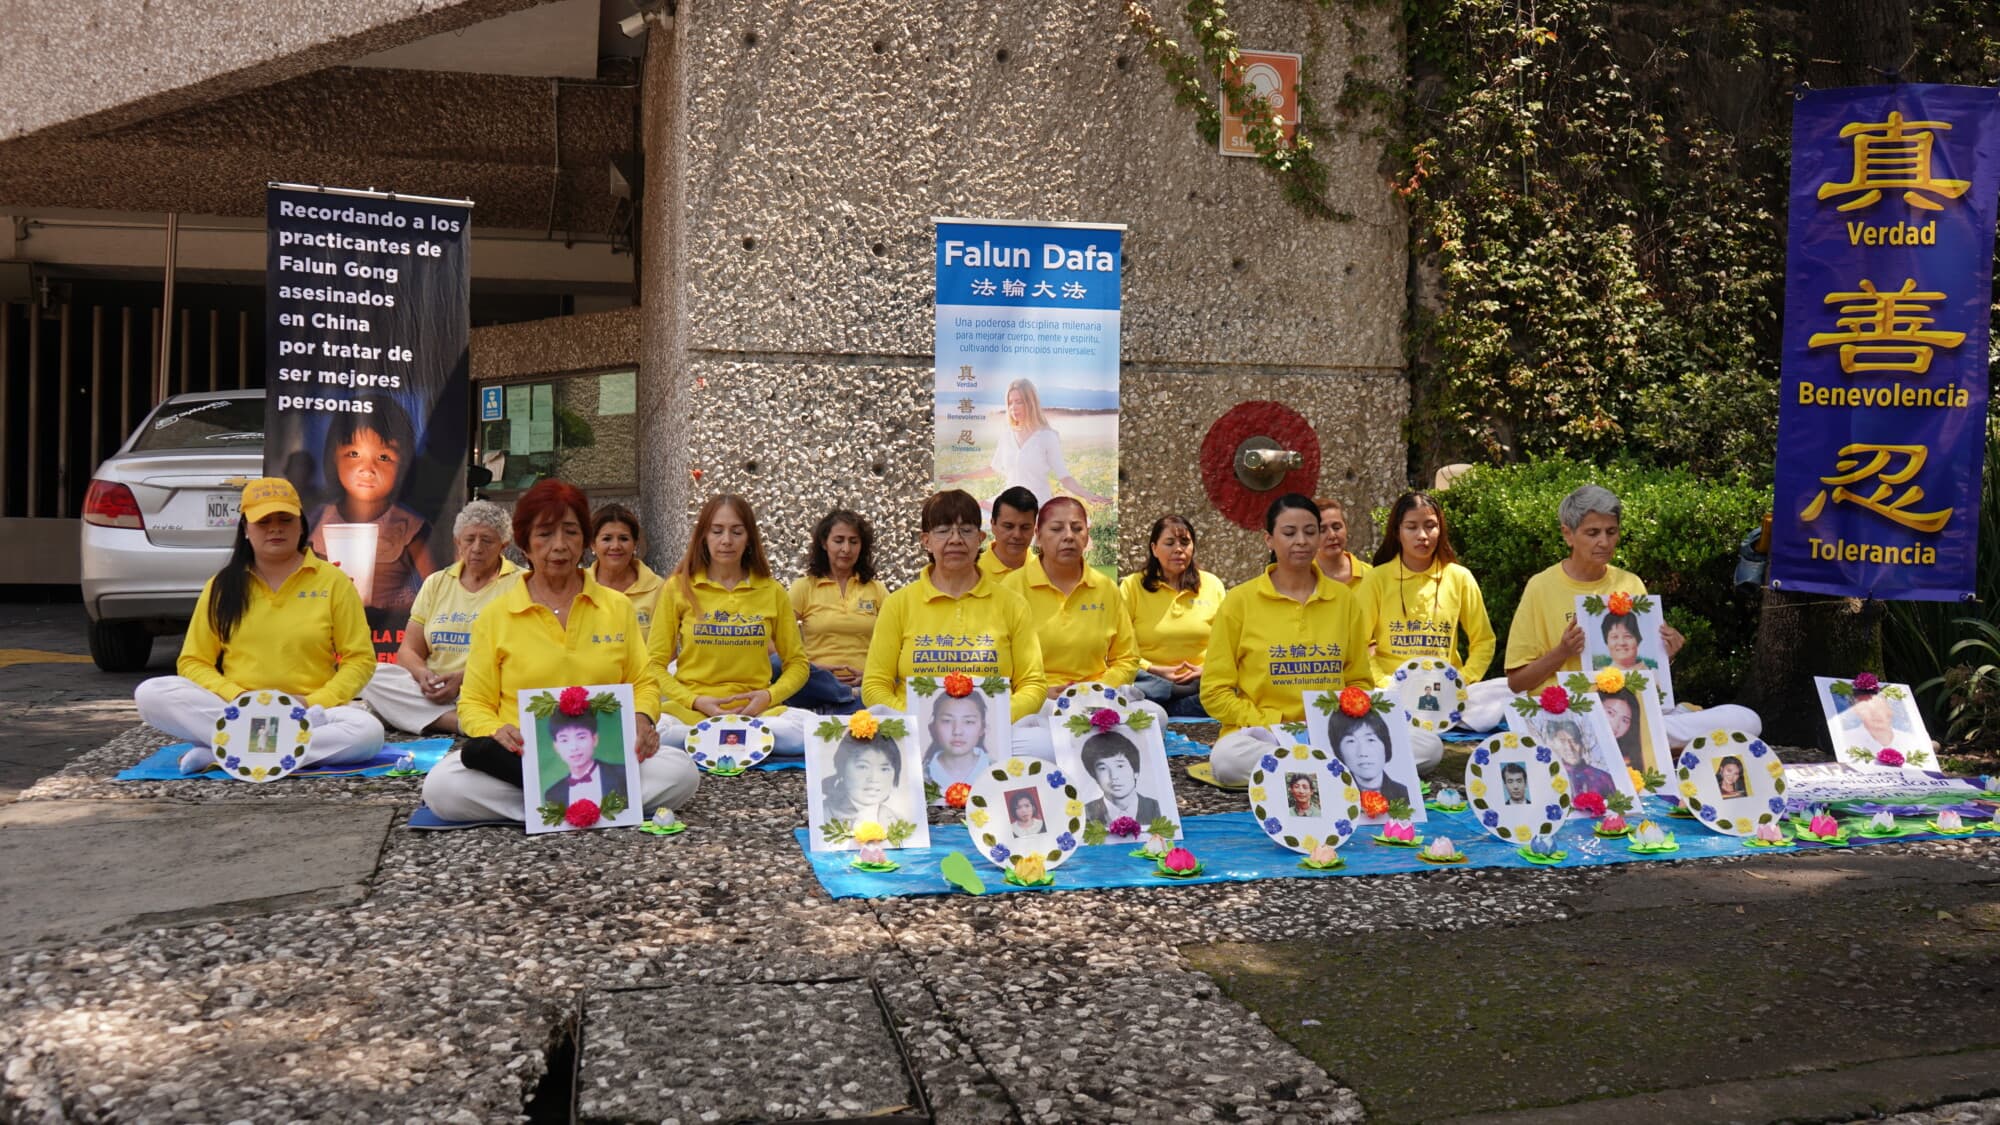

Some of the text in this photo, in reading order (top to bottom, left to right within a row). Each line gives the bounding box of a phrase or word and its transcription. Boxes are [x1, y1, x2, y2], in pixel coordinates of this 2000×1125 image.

[1817, 111, 1972, 212] 真
[280, 201, 460, 233] Recordando a los
[279, 230, 442, 257] practicantes de
[1847, 220, 1936, 246] Verdad
[945, 240, 1113, 271] Falun Dafa
[279, 255, 398, 283] Falun Gong
[279, 285, 395, 307] asesinados
[970, 278, 1088, 300] 法輪大法
[279, 312, 370, 332] en China
[955, 317, 1102, 331] Una poderosa disciplina milenaria
[1808, 278, 1967, 374] 善
[956, 331, 974, 340] para
[975, 331, 1005, 342] mejorar
[1038, 333, 1062, 341] mente
[279, 340, 413, 362] por tratar de
[960, 344, 1000, 353] cultivando
[1001, 344, 1013, 353] los
[1013, 345, 1051, 355] principios
[278, 367, 401, 389] ser mejores
[278, 395, 374, 414] personas
[1798, 381, 1969, 408] Benevolencia
[1800, 443, 1954, 533] 忍
[1808, 537, 1936, 565] Tolerancia
[694, 625, 764, 635] FALUN DAFA
[1389, 619, 1452, 633] 法輪大法
[431, 632, 465, 643] FALUN
[914, 633, 995, 648] 法輪大法
[1391, 635, 1450, 648] FALUN DAFA
[913, 651, 997, 662] FALUN DAFA
[1269, 643, 1342, 658] 法輪大法
[913, 665, 999, 673] www.falundafa.org
[1271, 661, 1341, 675] FALUN DAFA
